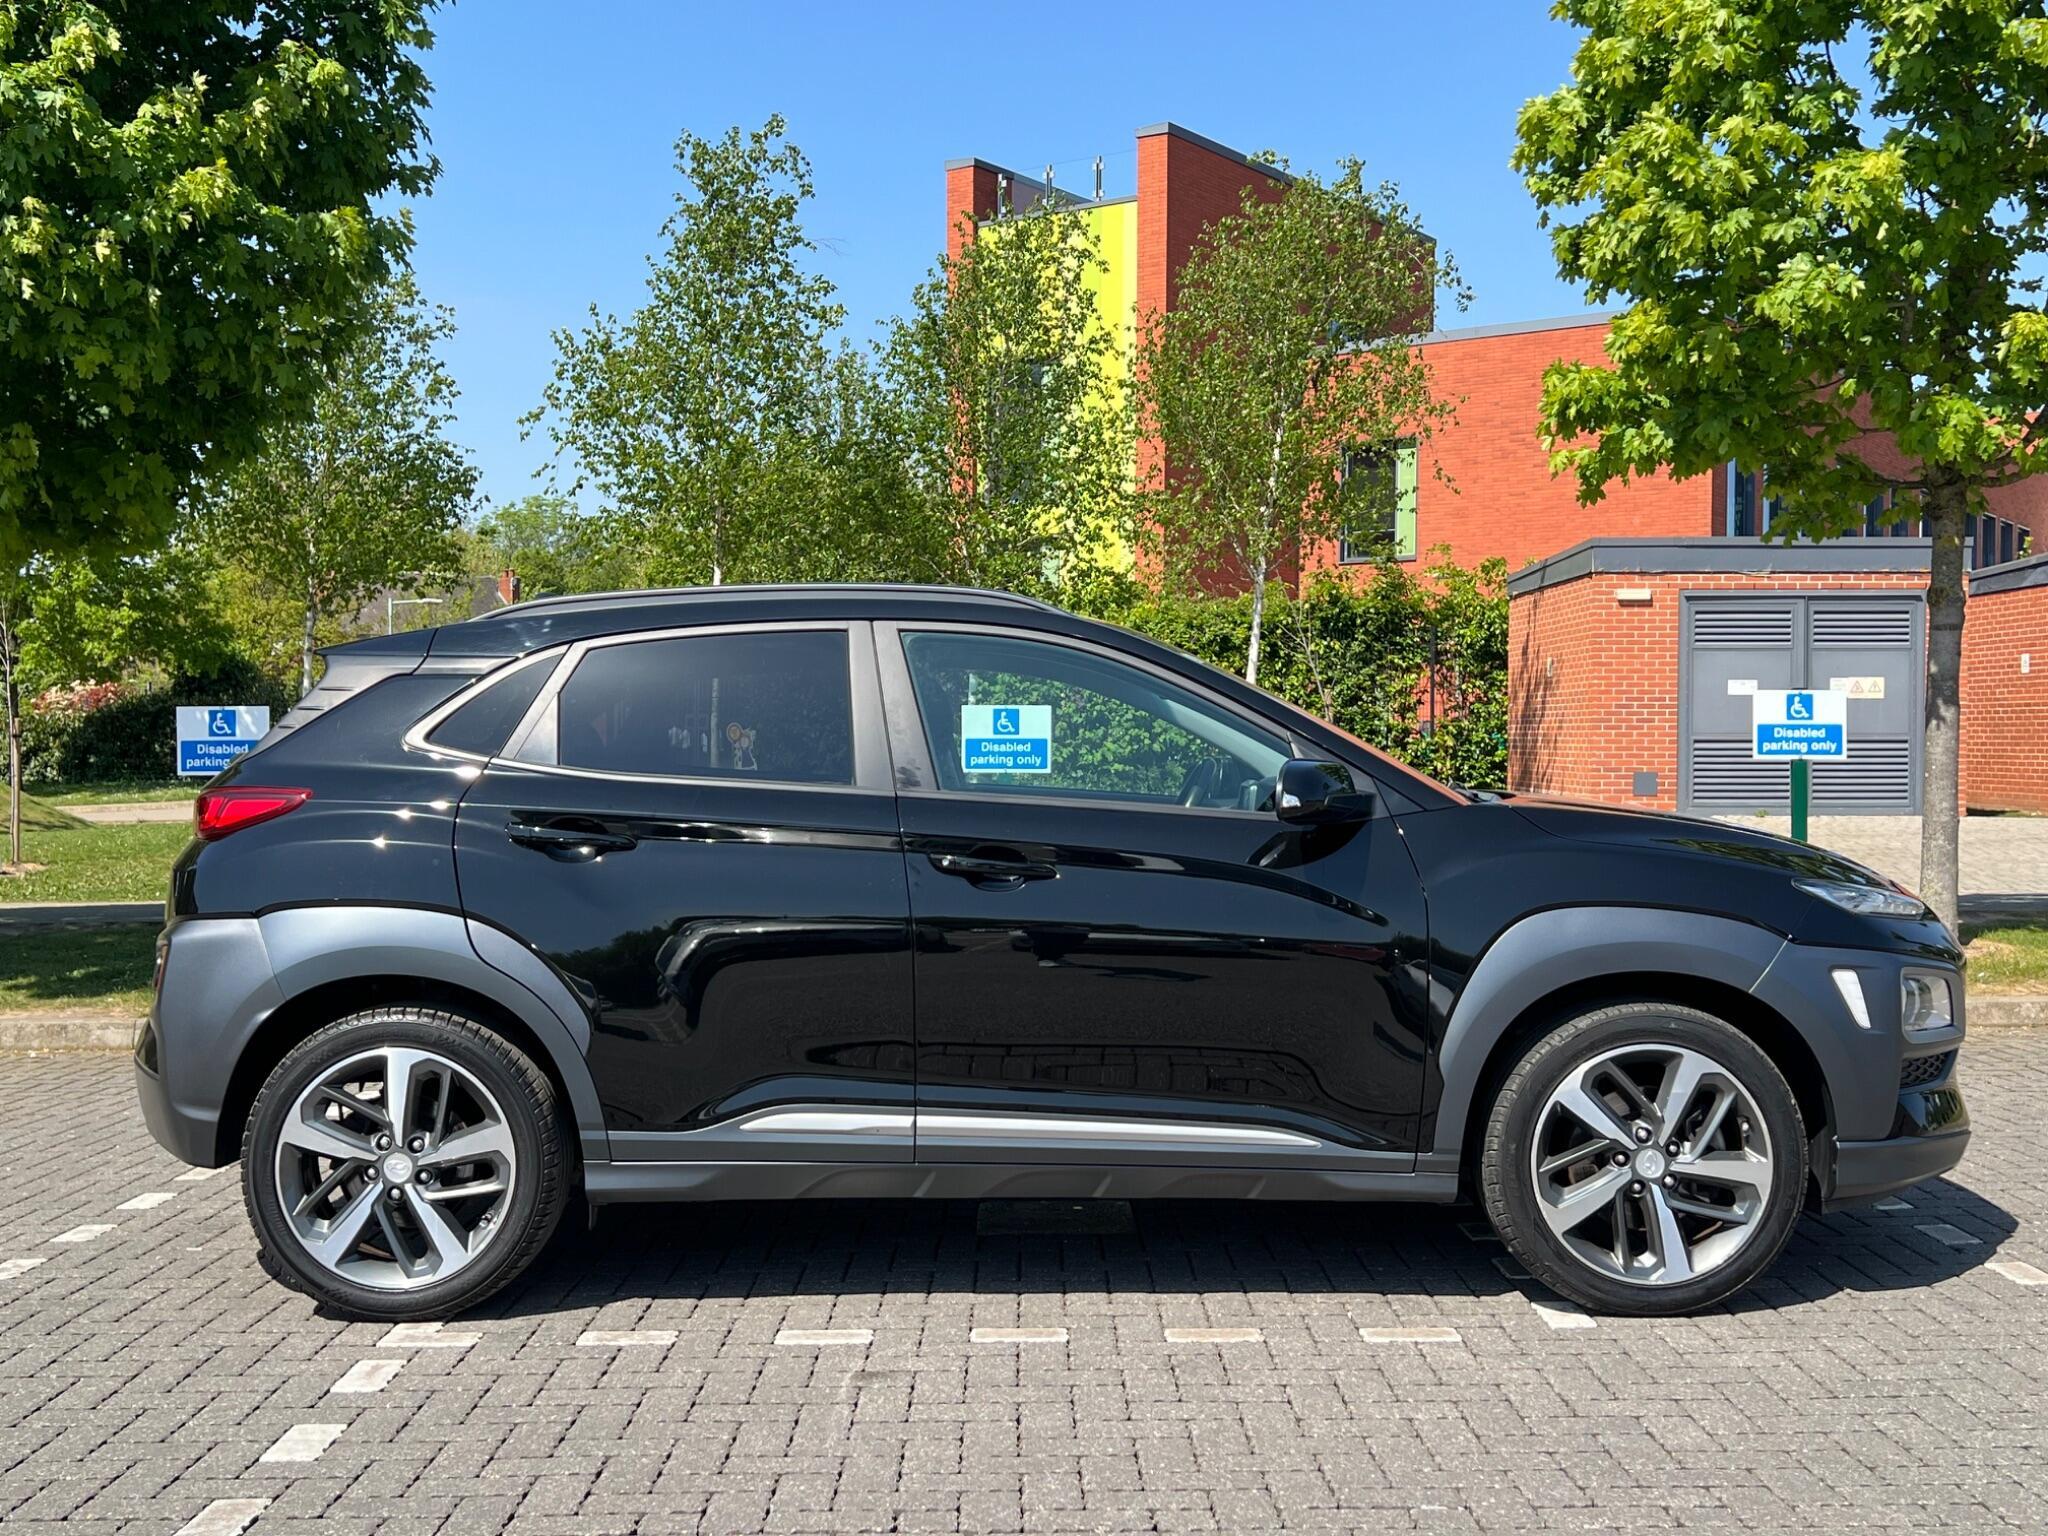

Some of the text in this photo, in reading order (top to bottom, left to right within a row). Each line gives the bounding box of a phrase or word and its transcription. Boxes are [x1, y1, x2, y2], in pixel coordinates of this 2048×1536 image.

[1773, 727, 1826, 738] Disabled
[196, 743, 249, 754] Disabled
[981, 742, 1031, 752] Disabled
[1762, 740, 1837, 753] parking only
[970, 754, 1042, 767] parking only
